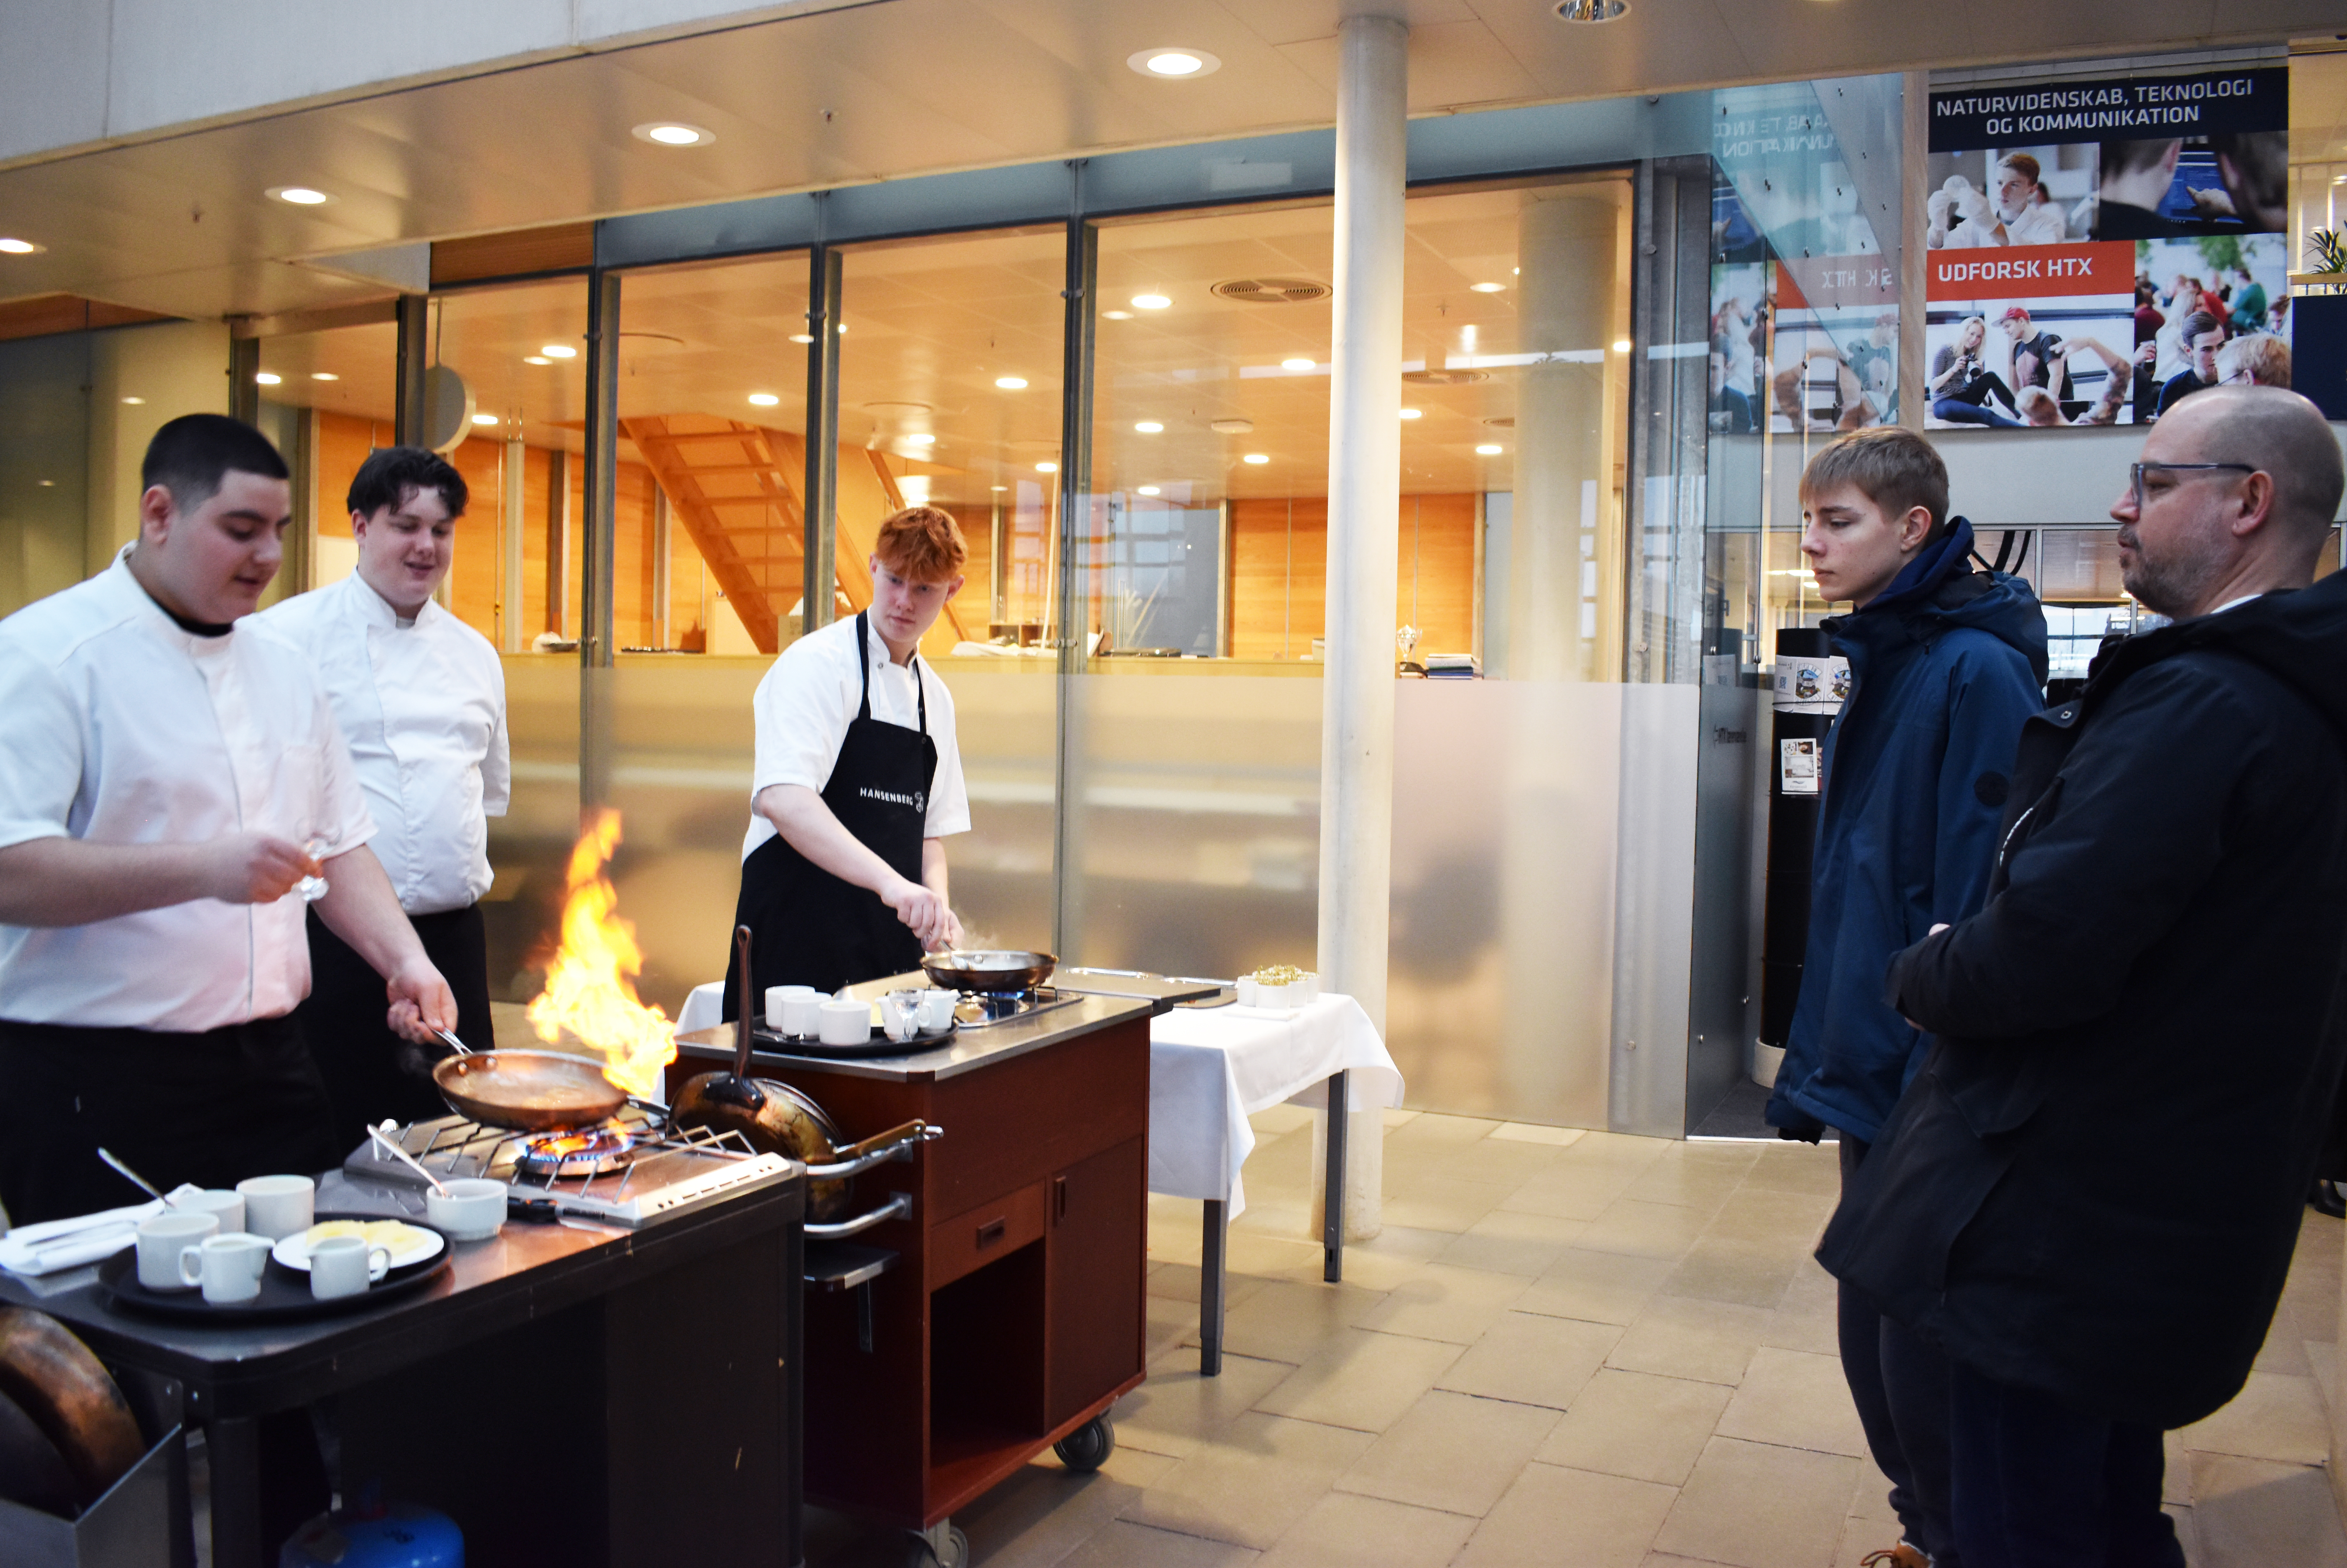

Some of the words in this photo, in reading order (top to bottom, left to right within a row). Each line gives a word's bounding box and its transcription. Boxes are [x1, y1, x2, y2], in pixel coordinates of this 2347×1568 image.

[1937, 87, 2128, 116] NATURVIDENSKAB,
[2135, 78, 2252, 103] TEKNOLOGI
[1986, 117, 2013, 135] OG
[2018, 105, 2200, 133] KOMMUNIKATION
[1939, 259, 2041, 282] UDFORSK
[2048, 257, 2093, 277] HTX
[860, 787, 913, 806] HANSENBERG
